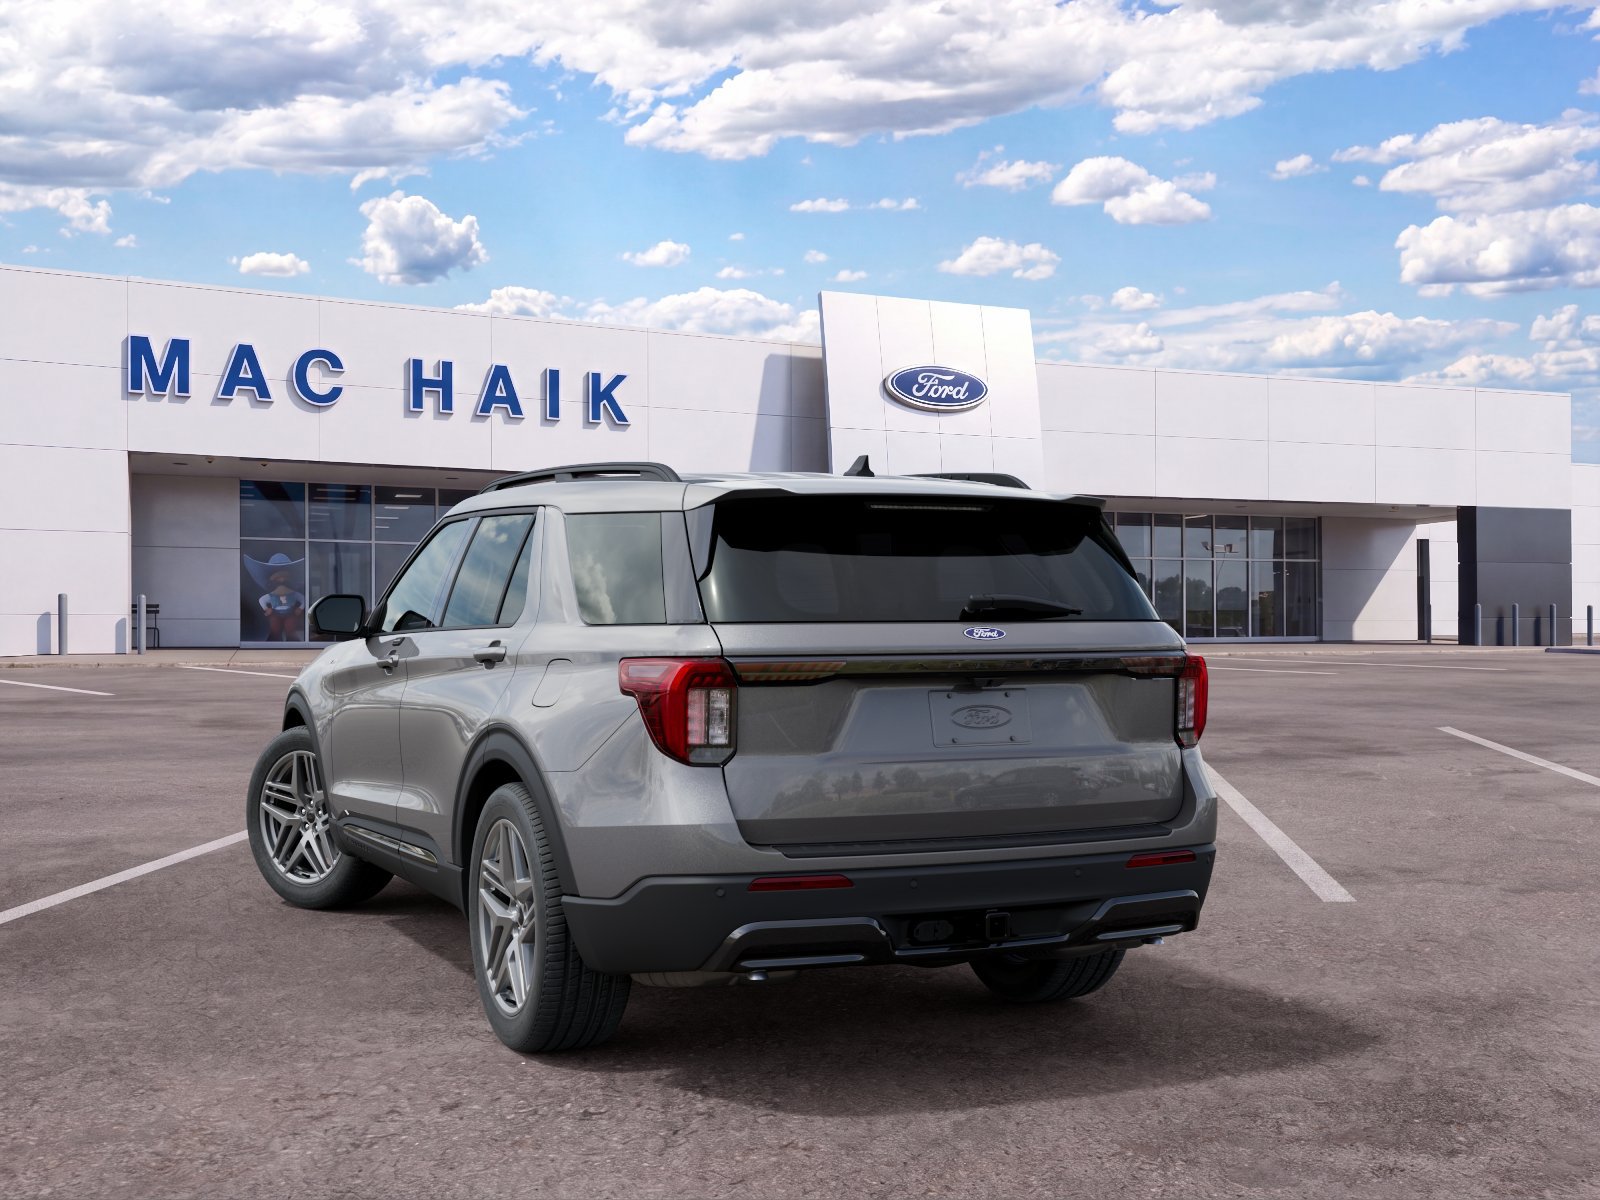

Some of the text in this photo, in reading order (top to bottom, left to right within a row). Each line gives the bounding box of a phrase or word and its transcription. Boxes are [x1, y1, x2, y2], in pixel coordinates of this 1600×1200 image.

[127, 333, 631, 425] MAC HAIK
[912, 372, 969, 400] Ford
[973, 628, 999, 638] Ford
